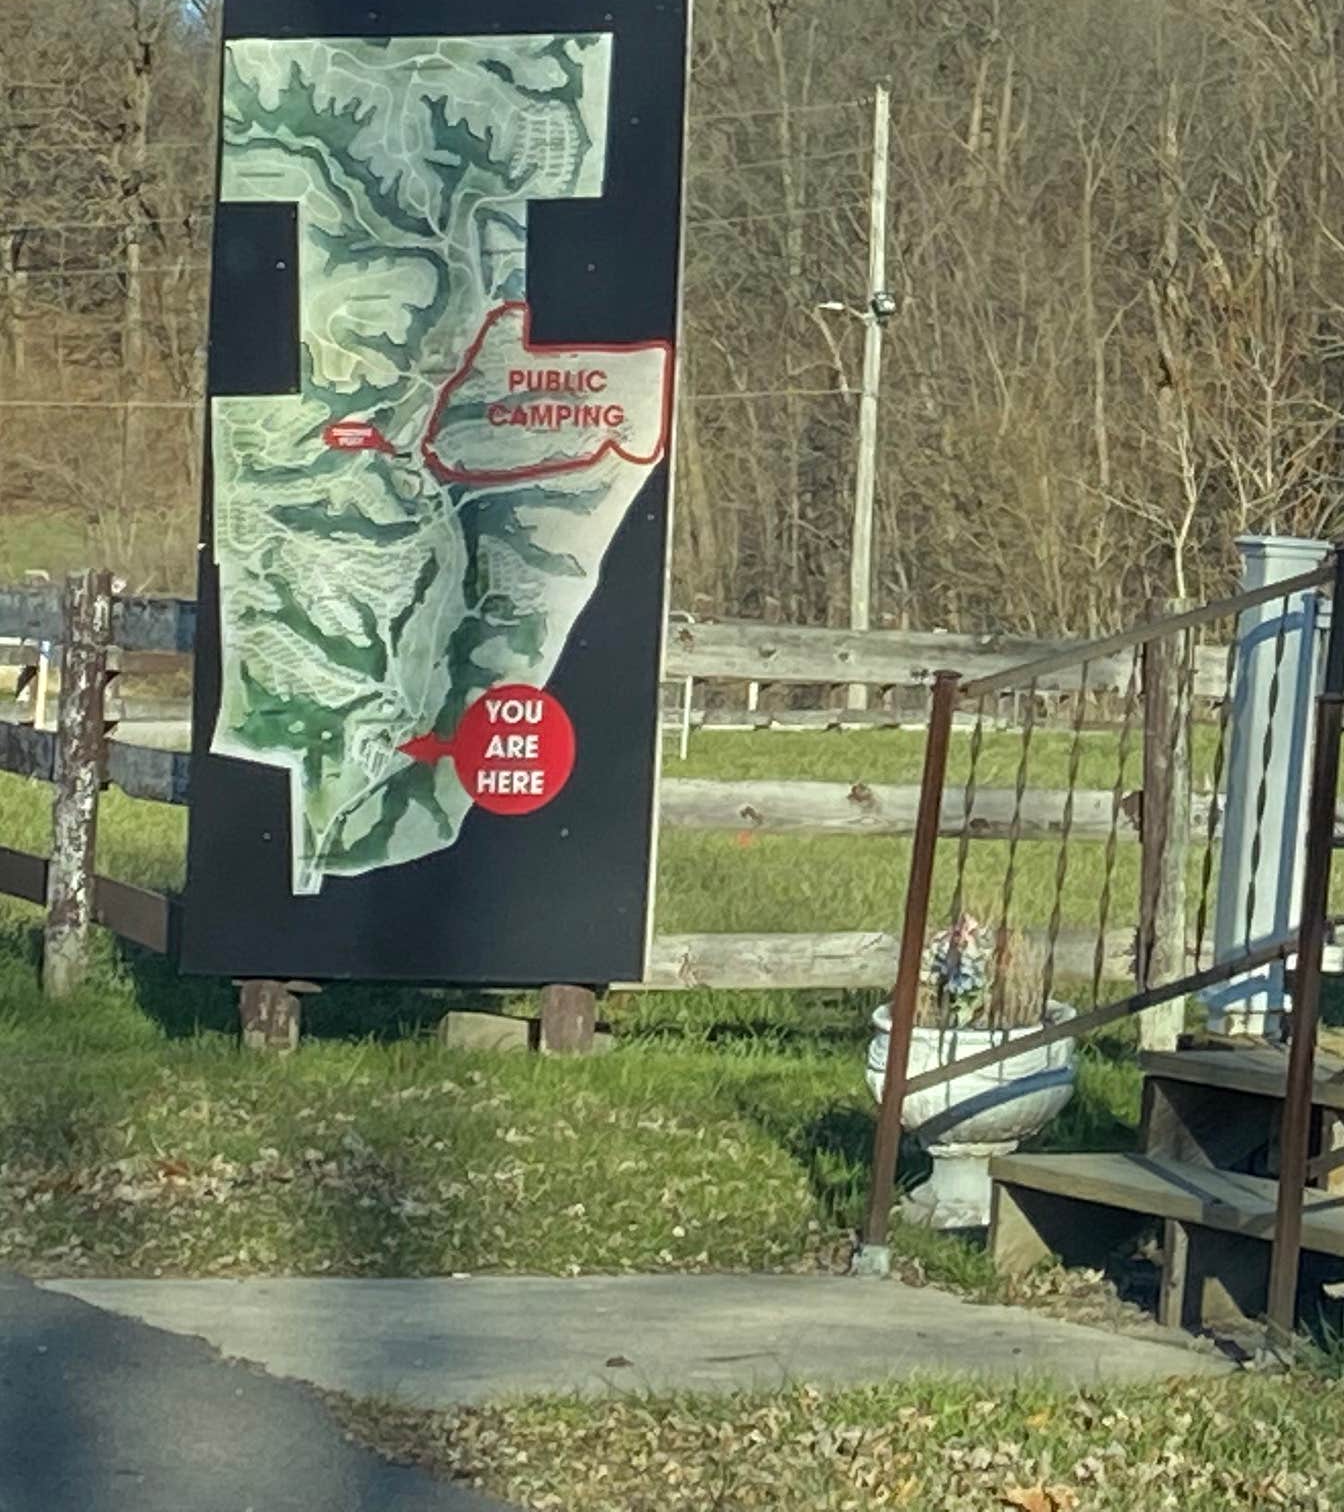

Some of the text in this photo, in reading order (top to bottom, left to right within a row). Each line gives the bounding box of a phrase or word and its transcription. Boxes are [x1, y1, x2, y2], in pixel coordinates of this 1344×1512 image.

[508, 369, 608, 393] PUBLIC
[487, 403, 625, 429] CAMPING
[485, 699, 544, 724] YOU
[484, 734, 540, 759] ARE
[477, 769, 545, 796] HERE
